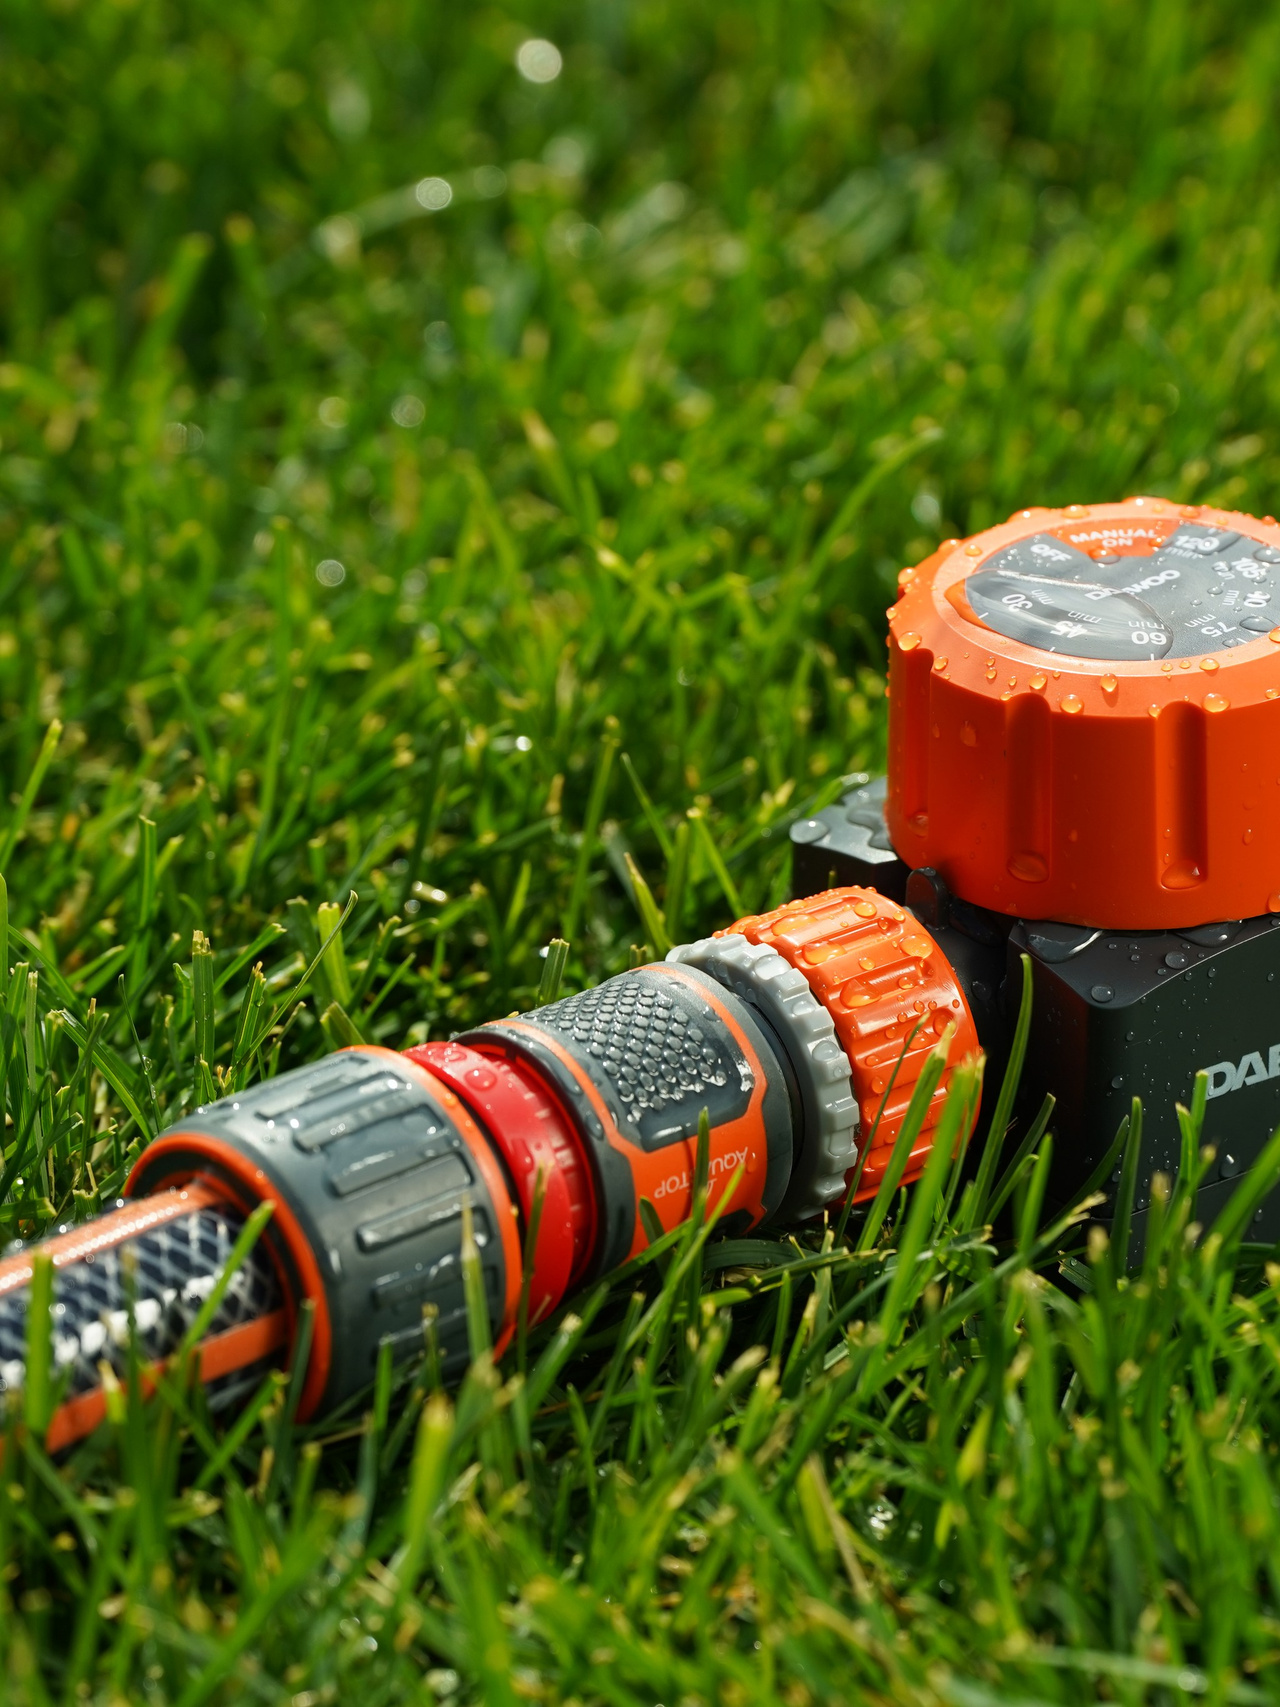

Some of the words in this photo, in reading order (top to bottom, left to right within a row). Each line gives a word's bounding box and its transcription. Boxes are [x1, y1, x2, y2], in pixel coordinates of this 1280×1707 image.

[1070, 528, 1157, 543] MANUAL
[1102, 538, 1133, 547] ON
[1175, 535, 1220, 551] 120
[1030, 544, 1072, 561] OFF
[1002, 593, 1033, 612] 30
[1067, 610, 1102, 624] min
[1184, 613, 1216, 628] min
[1050, 620, 1088, 638] 45
[1201, 621, 1237, 637] 75
[1131, 631, 1167, 645] 60
[654, 1146, 748, 1199] AQUTOP
